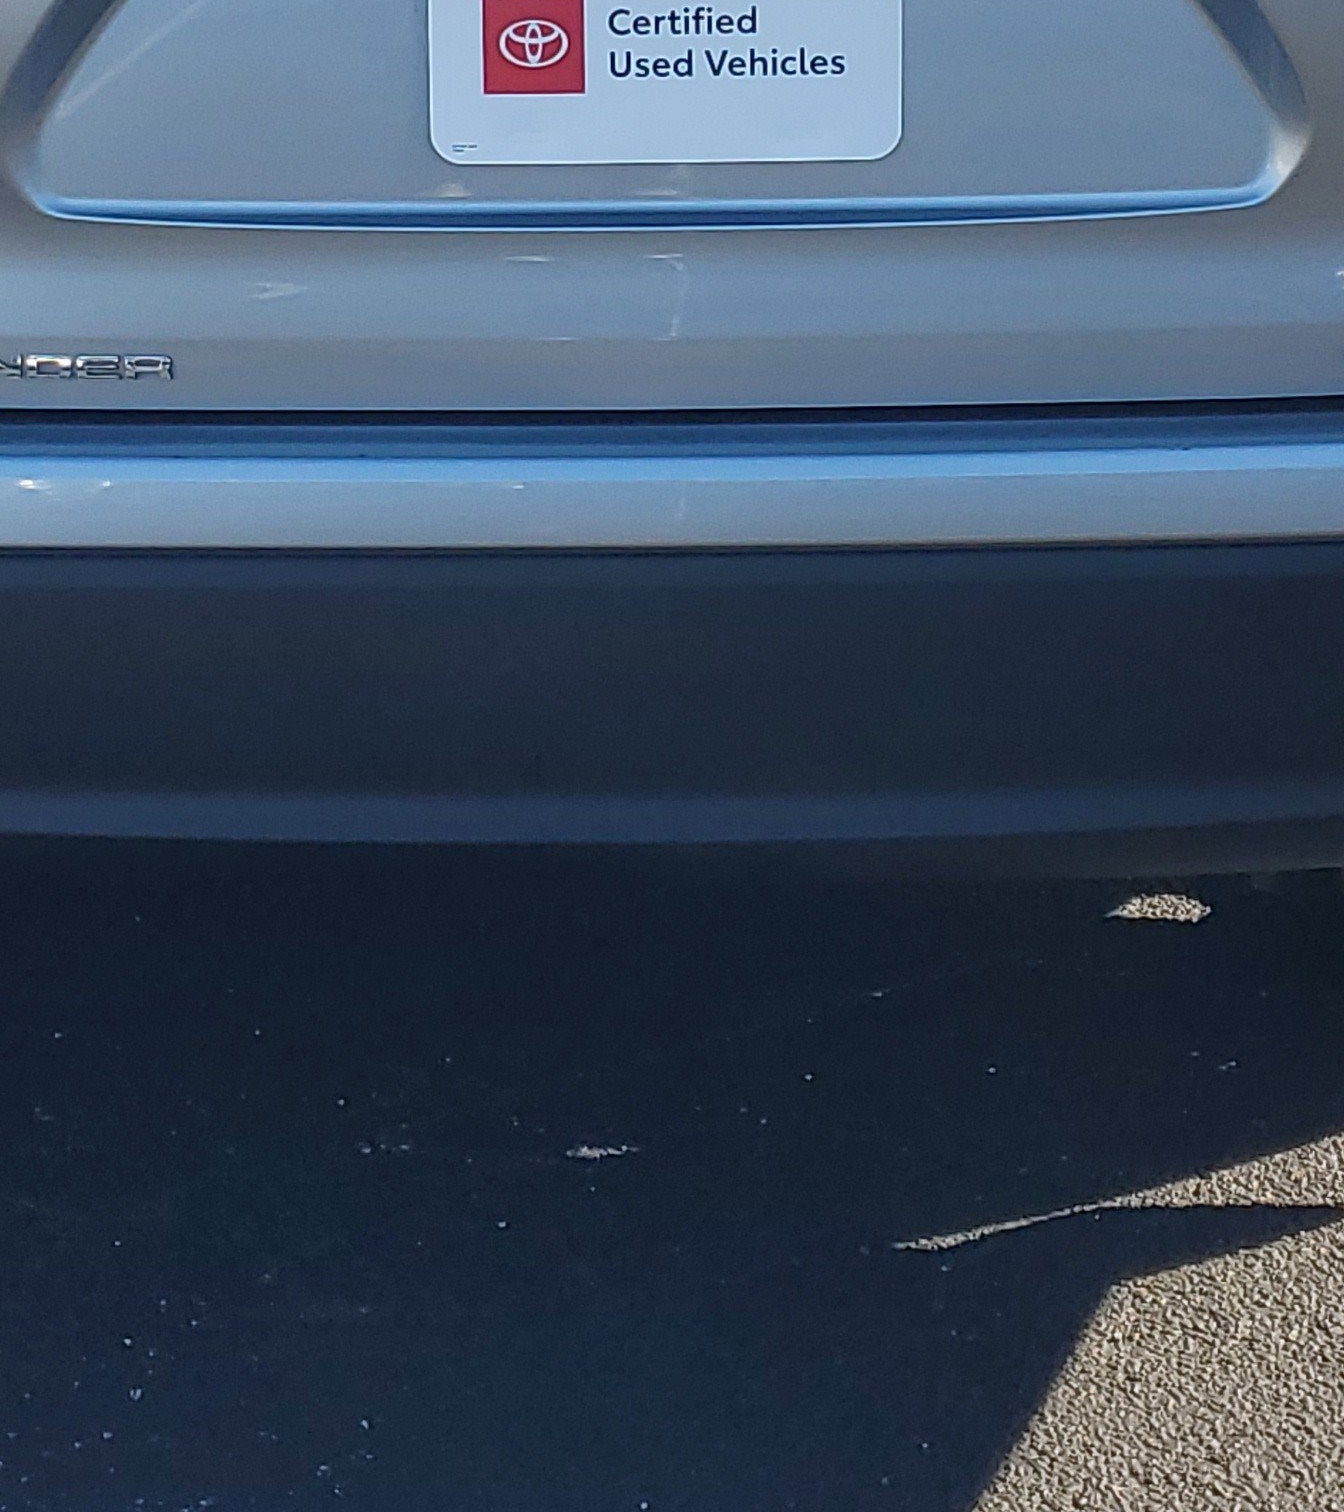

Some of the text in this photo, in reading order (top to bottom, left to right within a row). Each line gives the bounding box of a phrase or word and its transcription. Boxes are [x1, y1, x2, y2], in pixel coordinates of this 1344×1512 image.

[607, 5, 758, 36] Certified
[609, 46, 847, 78] Used Vehicles
